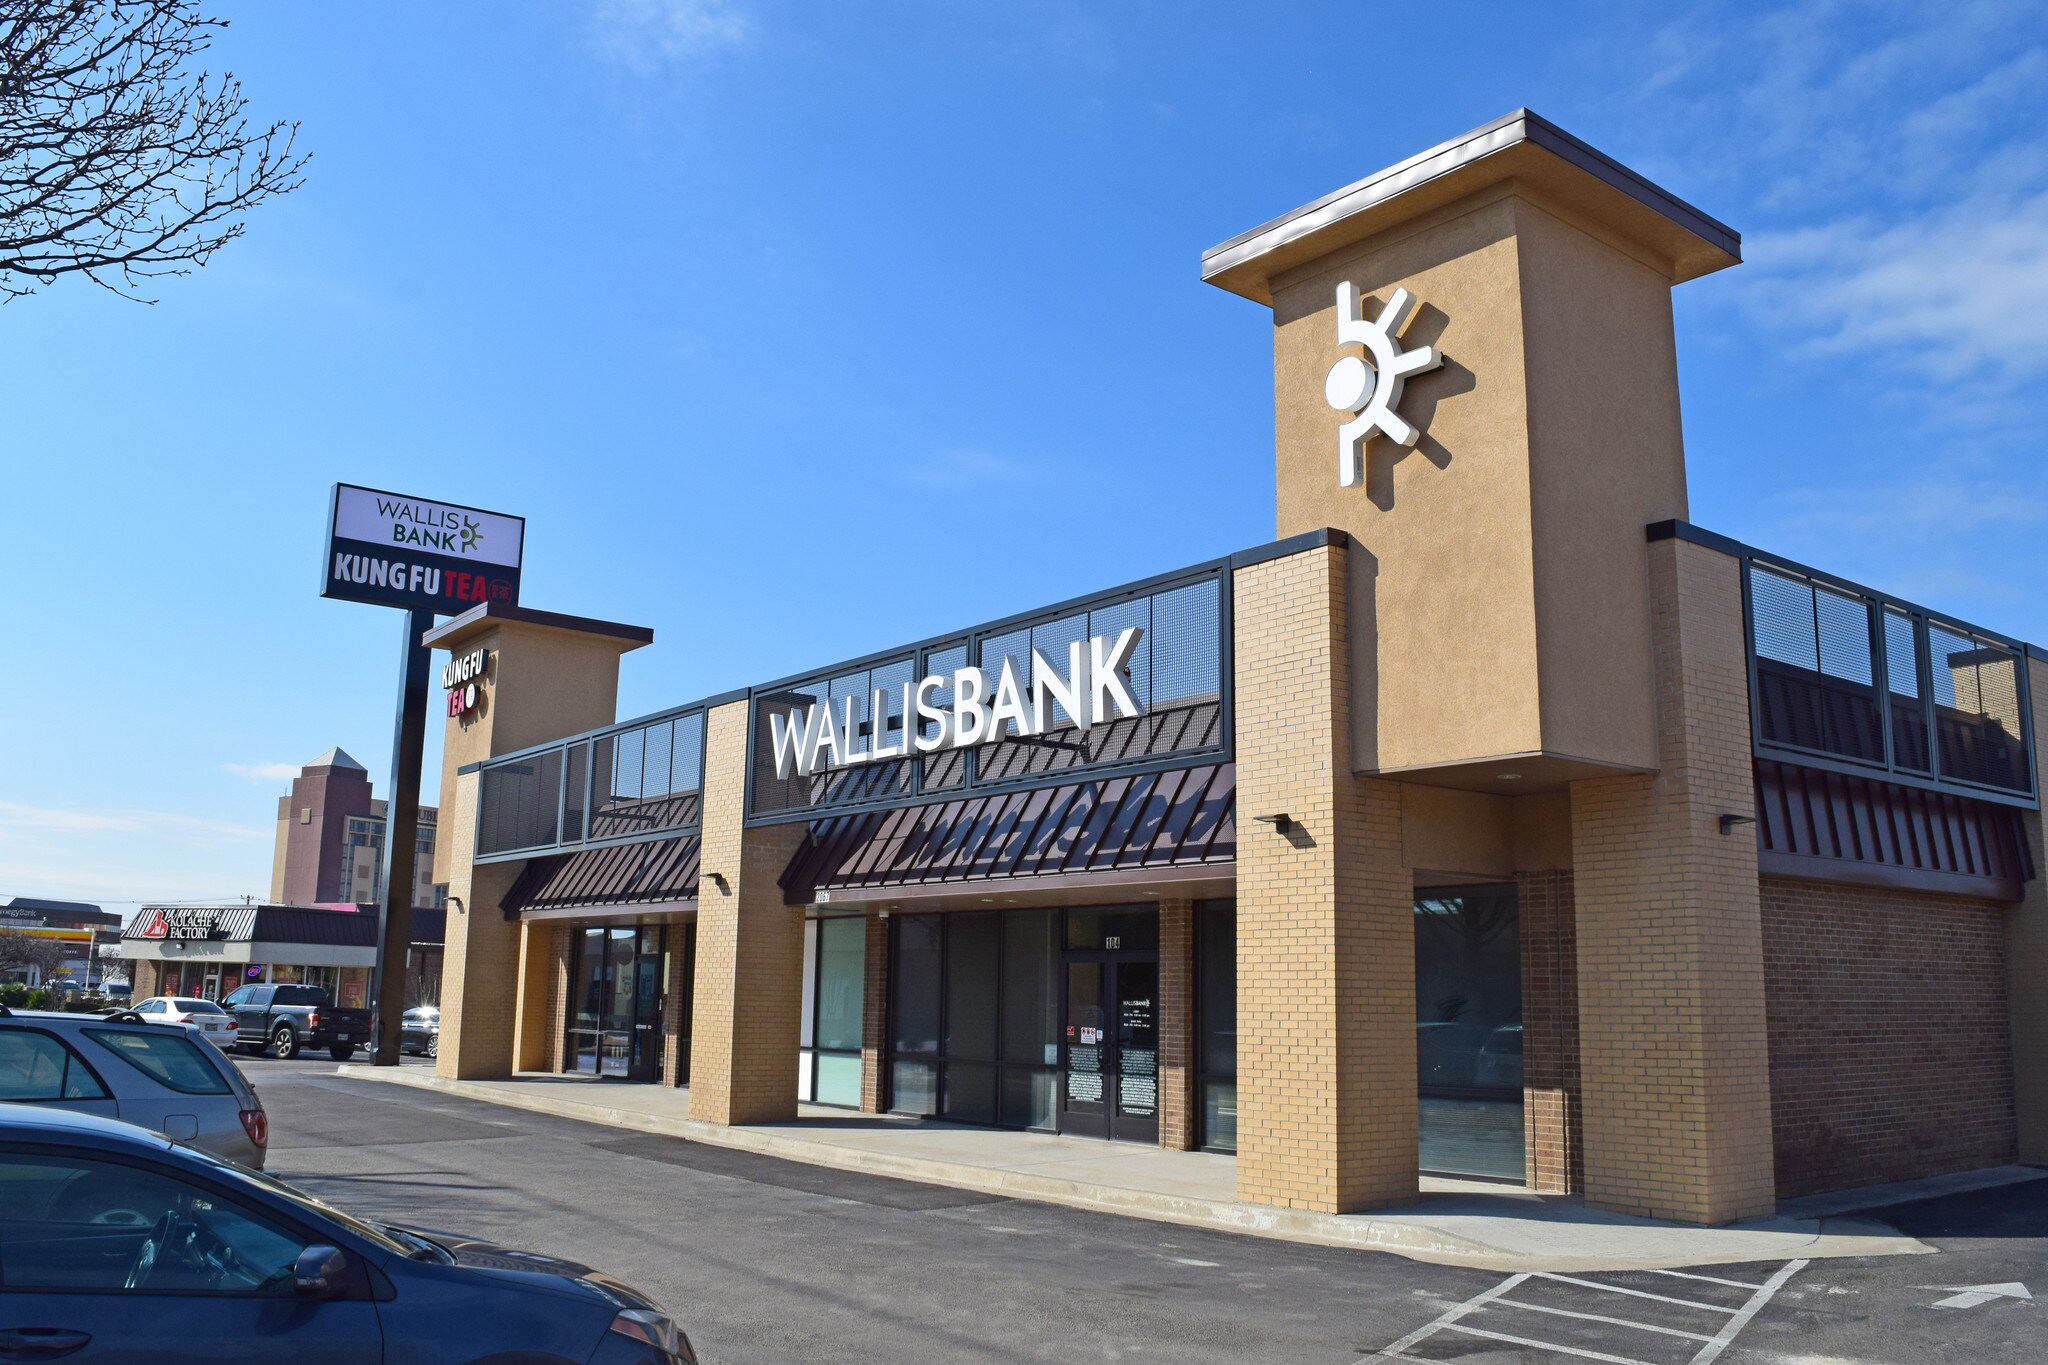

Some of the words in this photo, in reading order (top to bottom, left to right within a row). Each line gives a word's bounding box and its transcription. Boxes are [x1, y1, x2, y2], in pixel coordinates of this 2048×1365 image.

[377, 498, 459, 530] WALLIS
[393, 523, 457, 552] BANK
[444, 570, 487, 603] TEA
[447, 688, 465, 717] TEA
[769, 627, 1145, 780] WALLISBANK
[169, 927, 210, 939] FACTORY
[170, 914, 212, 927] KOLACHE
[1106, 936, 1120, 949] 104
